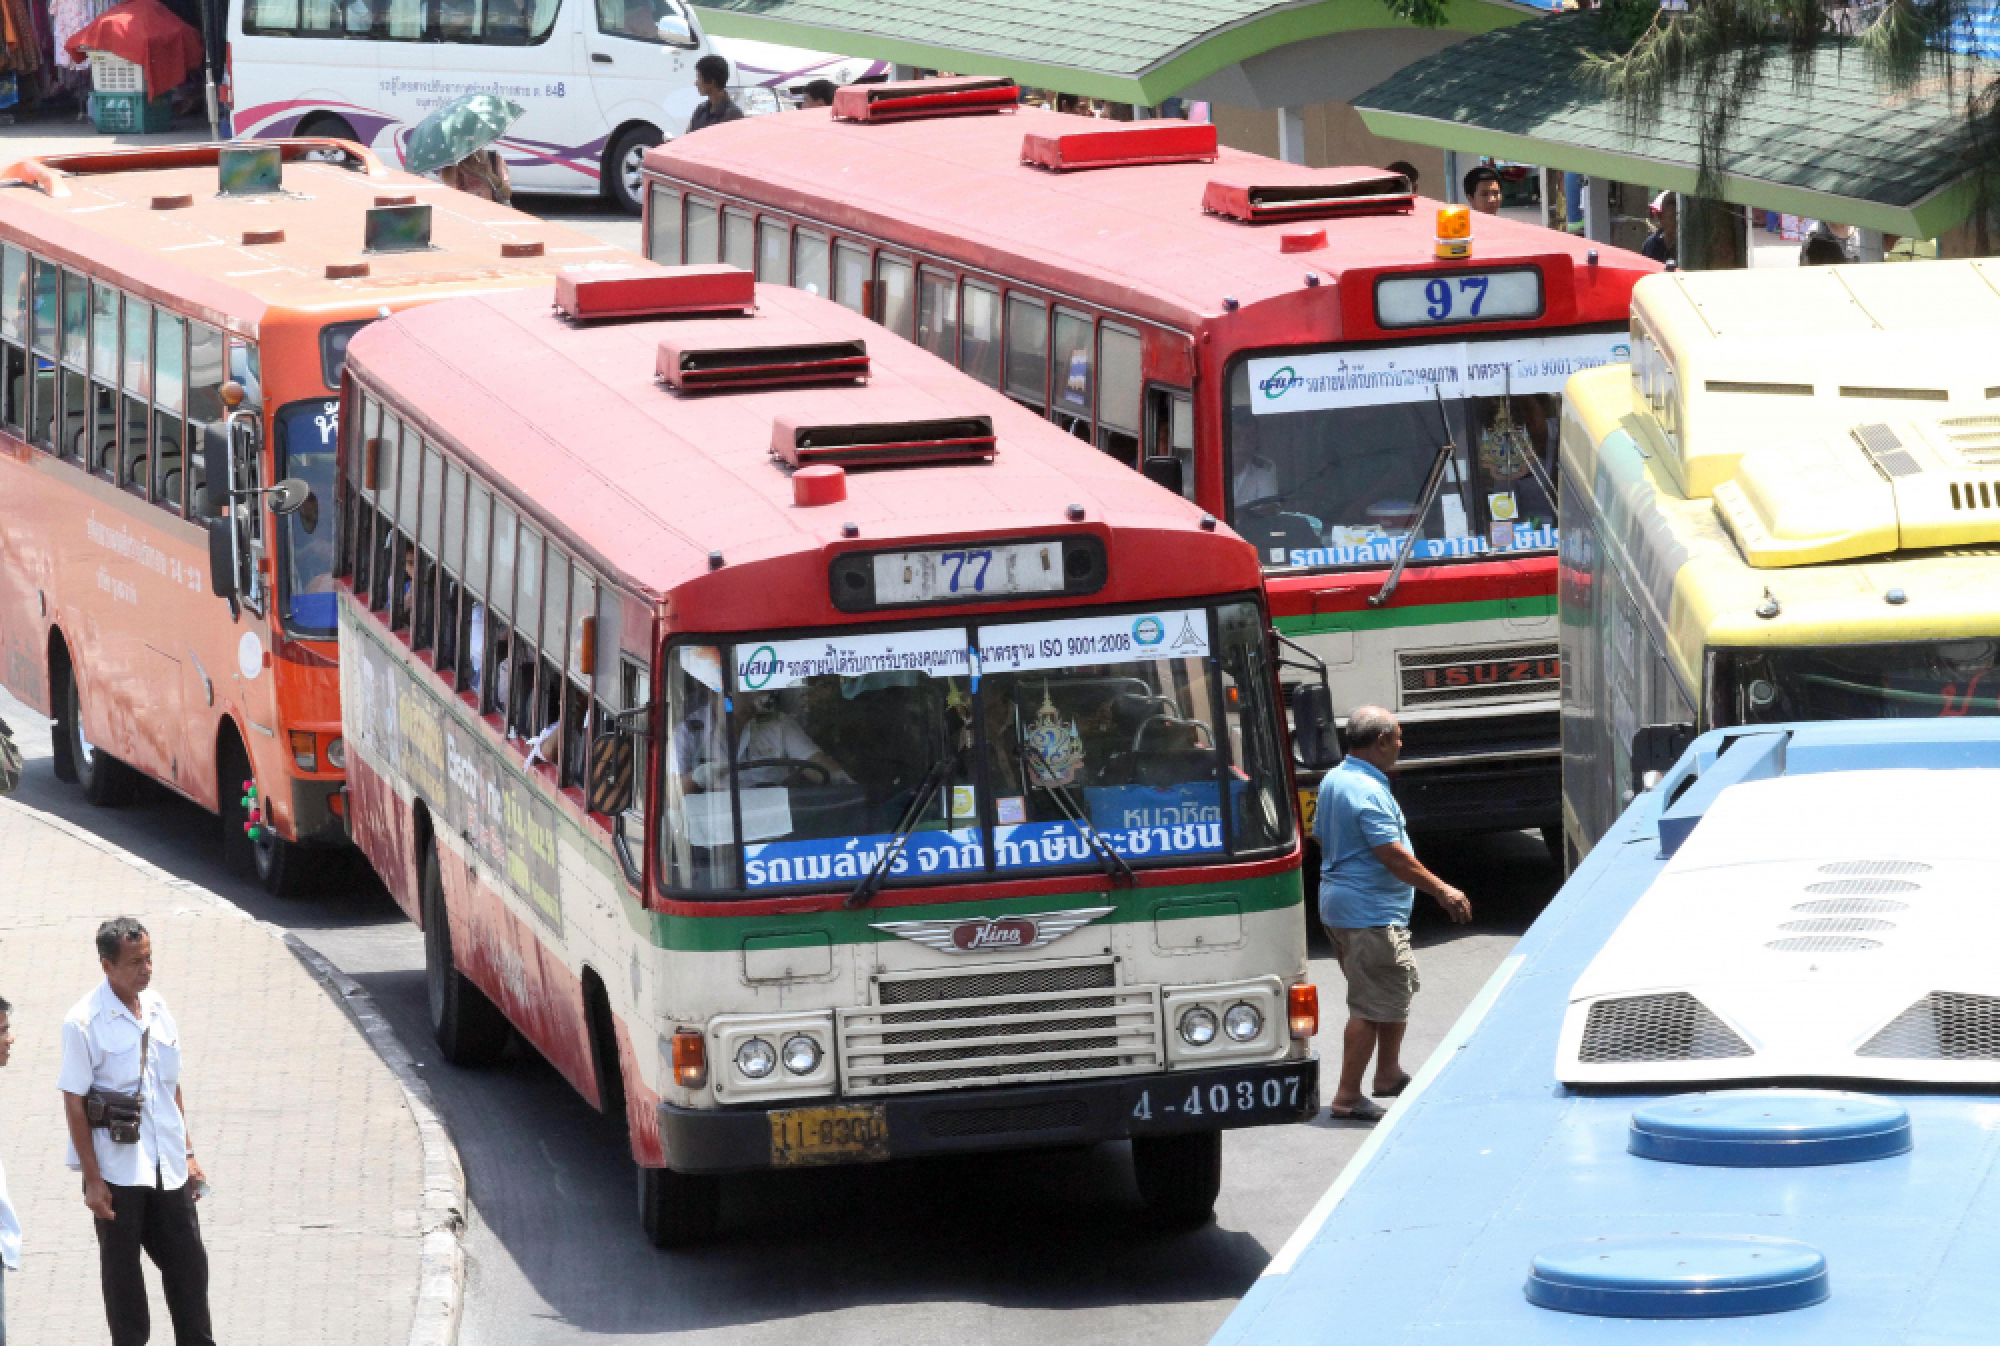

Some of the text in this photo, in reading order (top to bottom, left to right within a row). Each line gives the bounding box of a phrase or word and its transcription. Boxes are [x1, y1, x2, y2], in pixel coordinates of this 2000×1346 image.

[1425, 276, 1490, 320] 97
[941, 550, 993, 592] 77
[1039, 637, 1063, 659] ISO
[1424, 661, 1560, 687] ISUZU
[917, 843, 986, 873] จาก
[967, 921, 1022, 950] Hino
